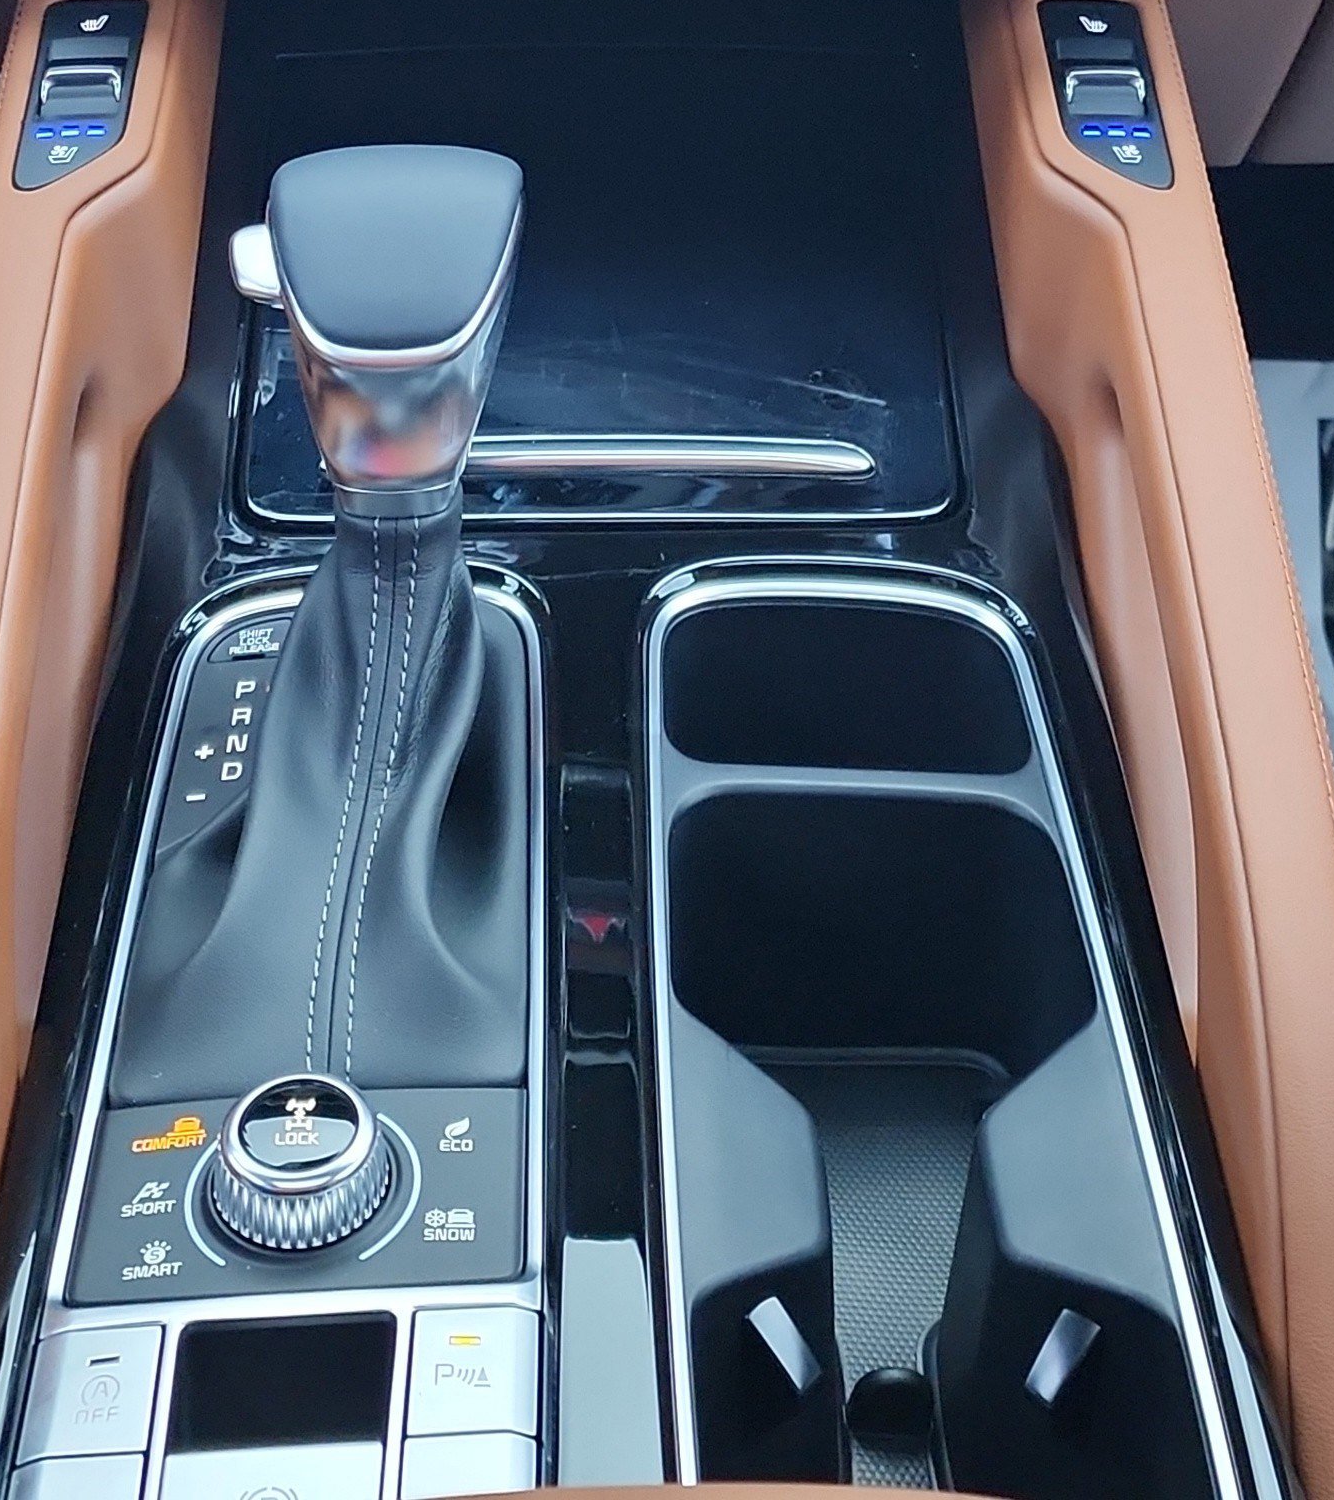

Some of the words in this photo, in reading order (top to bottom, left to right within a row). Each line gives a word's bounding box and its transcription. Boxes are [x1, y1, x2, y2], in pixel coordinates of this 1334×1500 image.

[238, 628, 273, 639] SHIFT
[240, 636, 270, 646] LOCK
[229, 642, 280, 655] RELEASE
[235, 680, 256, 700] P
[231, 707, 252, 726] R
[225, 734, 248, 754] N
[220, 762, 243, 781] D
[132, 1134, 207, 1152] COMFORT
[274, 1132, 319, 1146] LOCK
[439, 1139, 473, 1152] ECO
[120, 1199, 177, 1218] SPORT
[423, 1228, 475, 1241] SNOW
[122, 1261, 183, 1281] SMART
